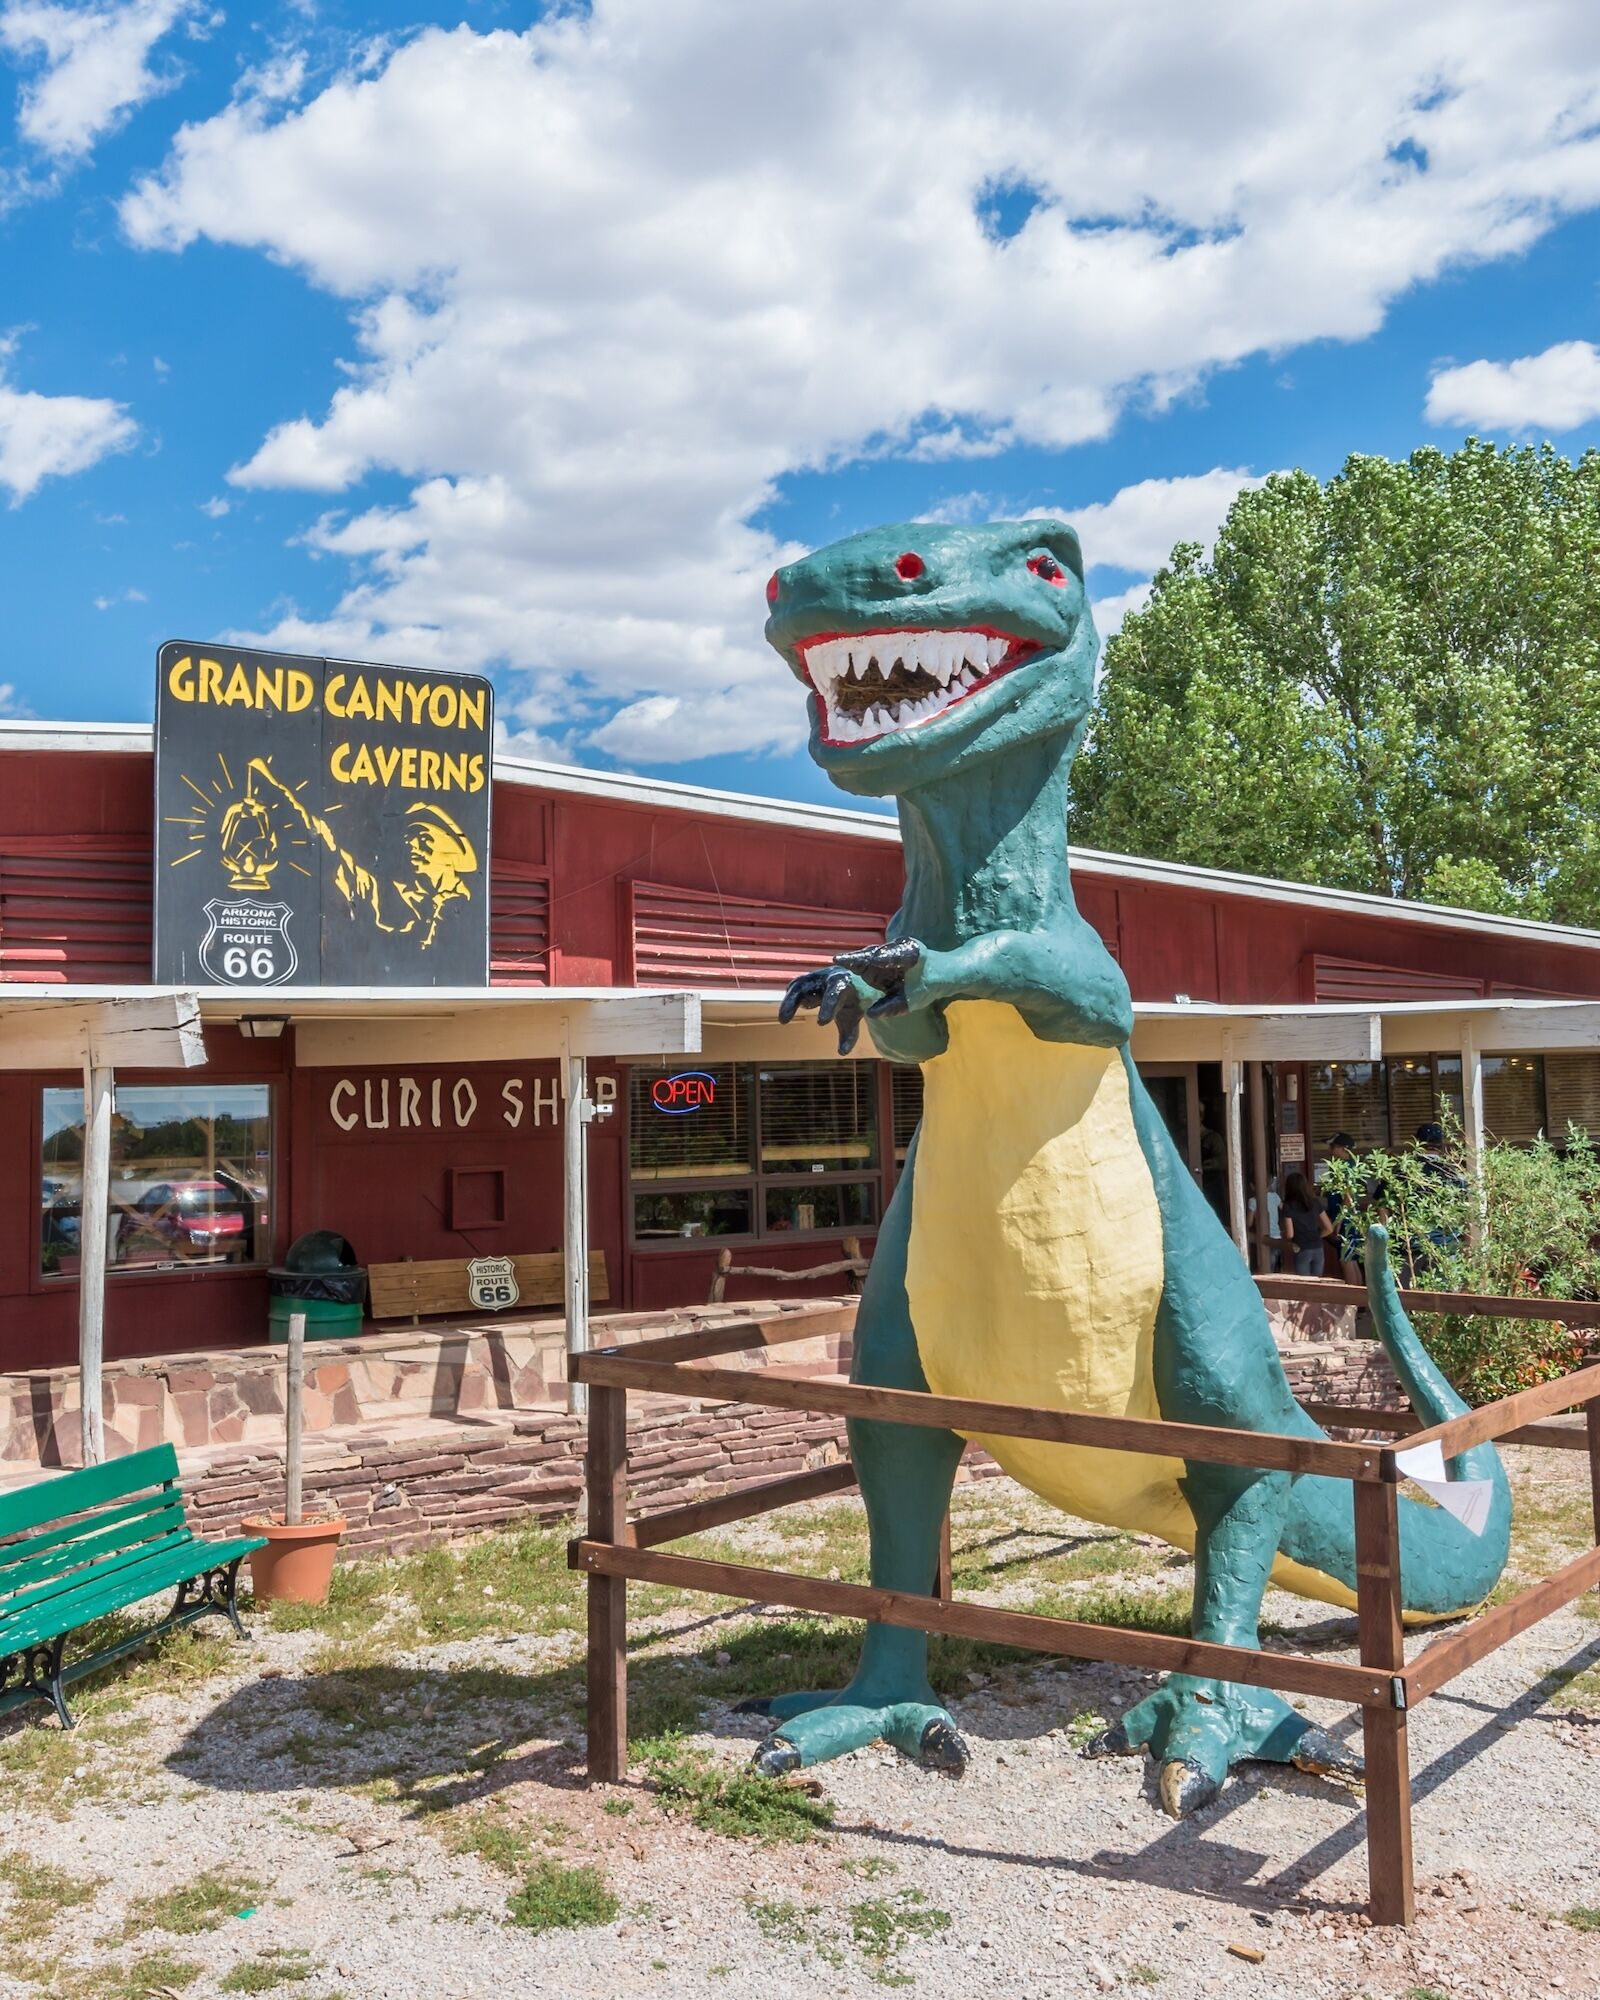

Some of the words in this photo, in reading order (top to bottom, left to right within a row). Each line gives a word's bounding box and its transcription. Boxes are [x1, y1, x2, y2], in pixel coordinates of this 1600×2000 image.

[168, 656, 314, 713] GRAND
[323, 673, 486, 731] CANYON
[330, 742, 486, 793] CAVERNS
[222, 908, 276, 917] ARIZONA
[221, 917, 277, 926] HISTORIC
[223, 933, 273, 944] ROUTE
[224, 947, 274, 979] 66
[653, 1079, 714, 1104] OPEN
[330, 1078, 477, 1130] CURIO
[502, 1076, 617, 1128] SHP
[476, 1264, 507, 1274] HISTORIC
[477, 1277, 510, 1286] ROUTE
[480, 1286, 511, 1303] 66
